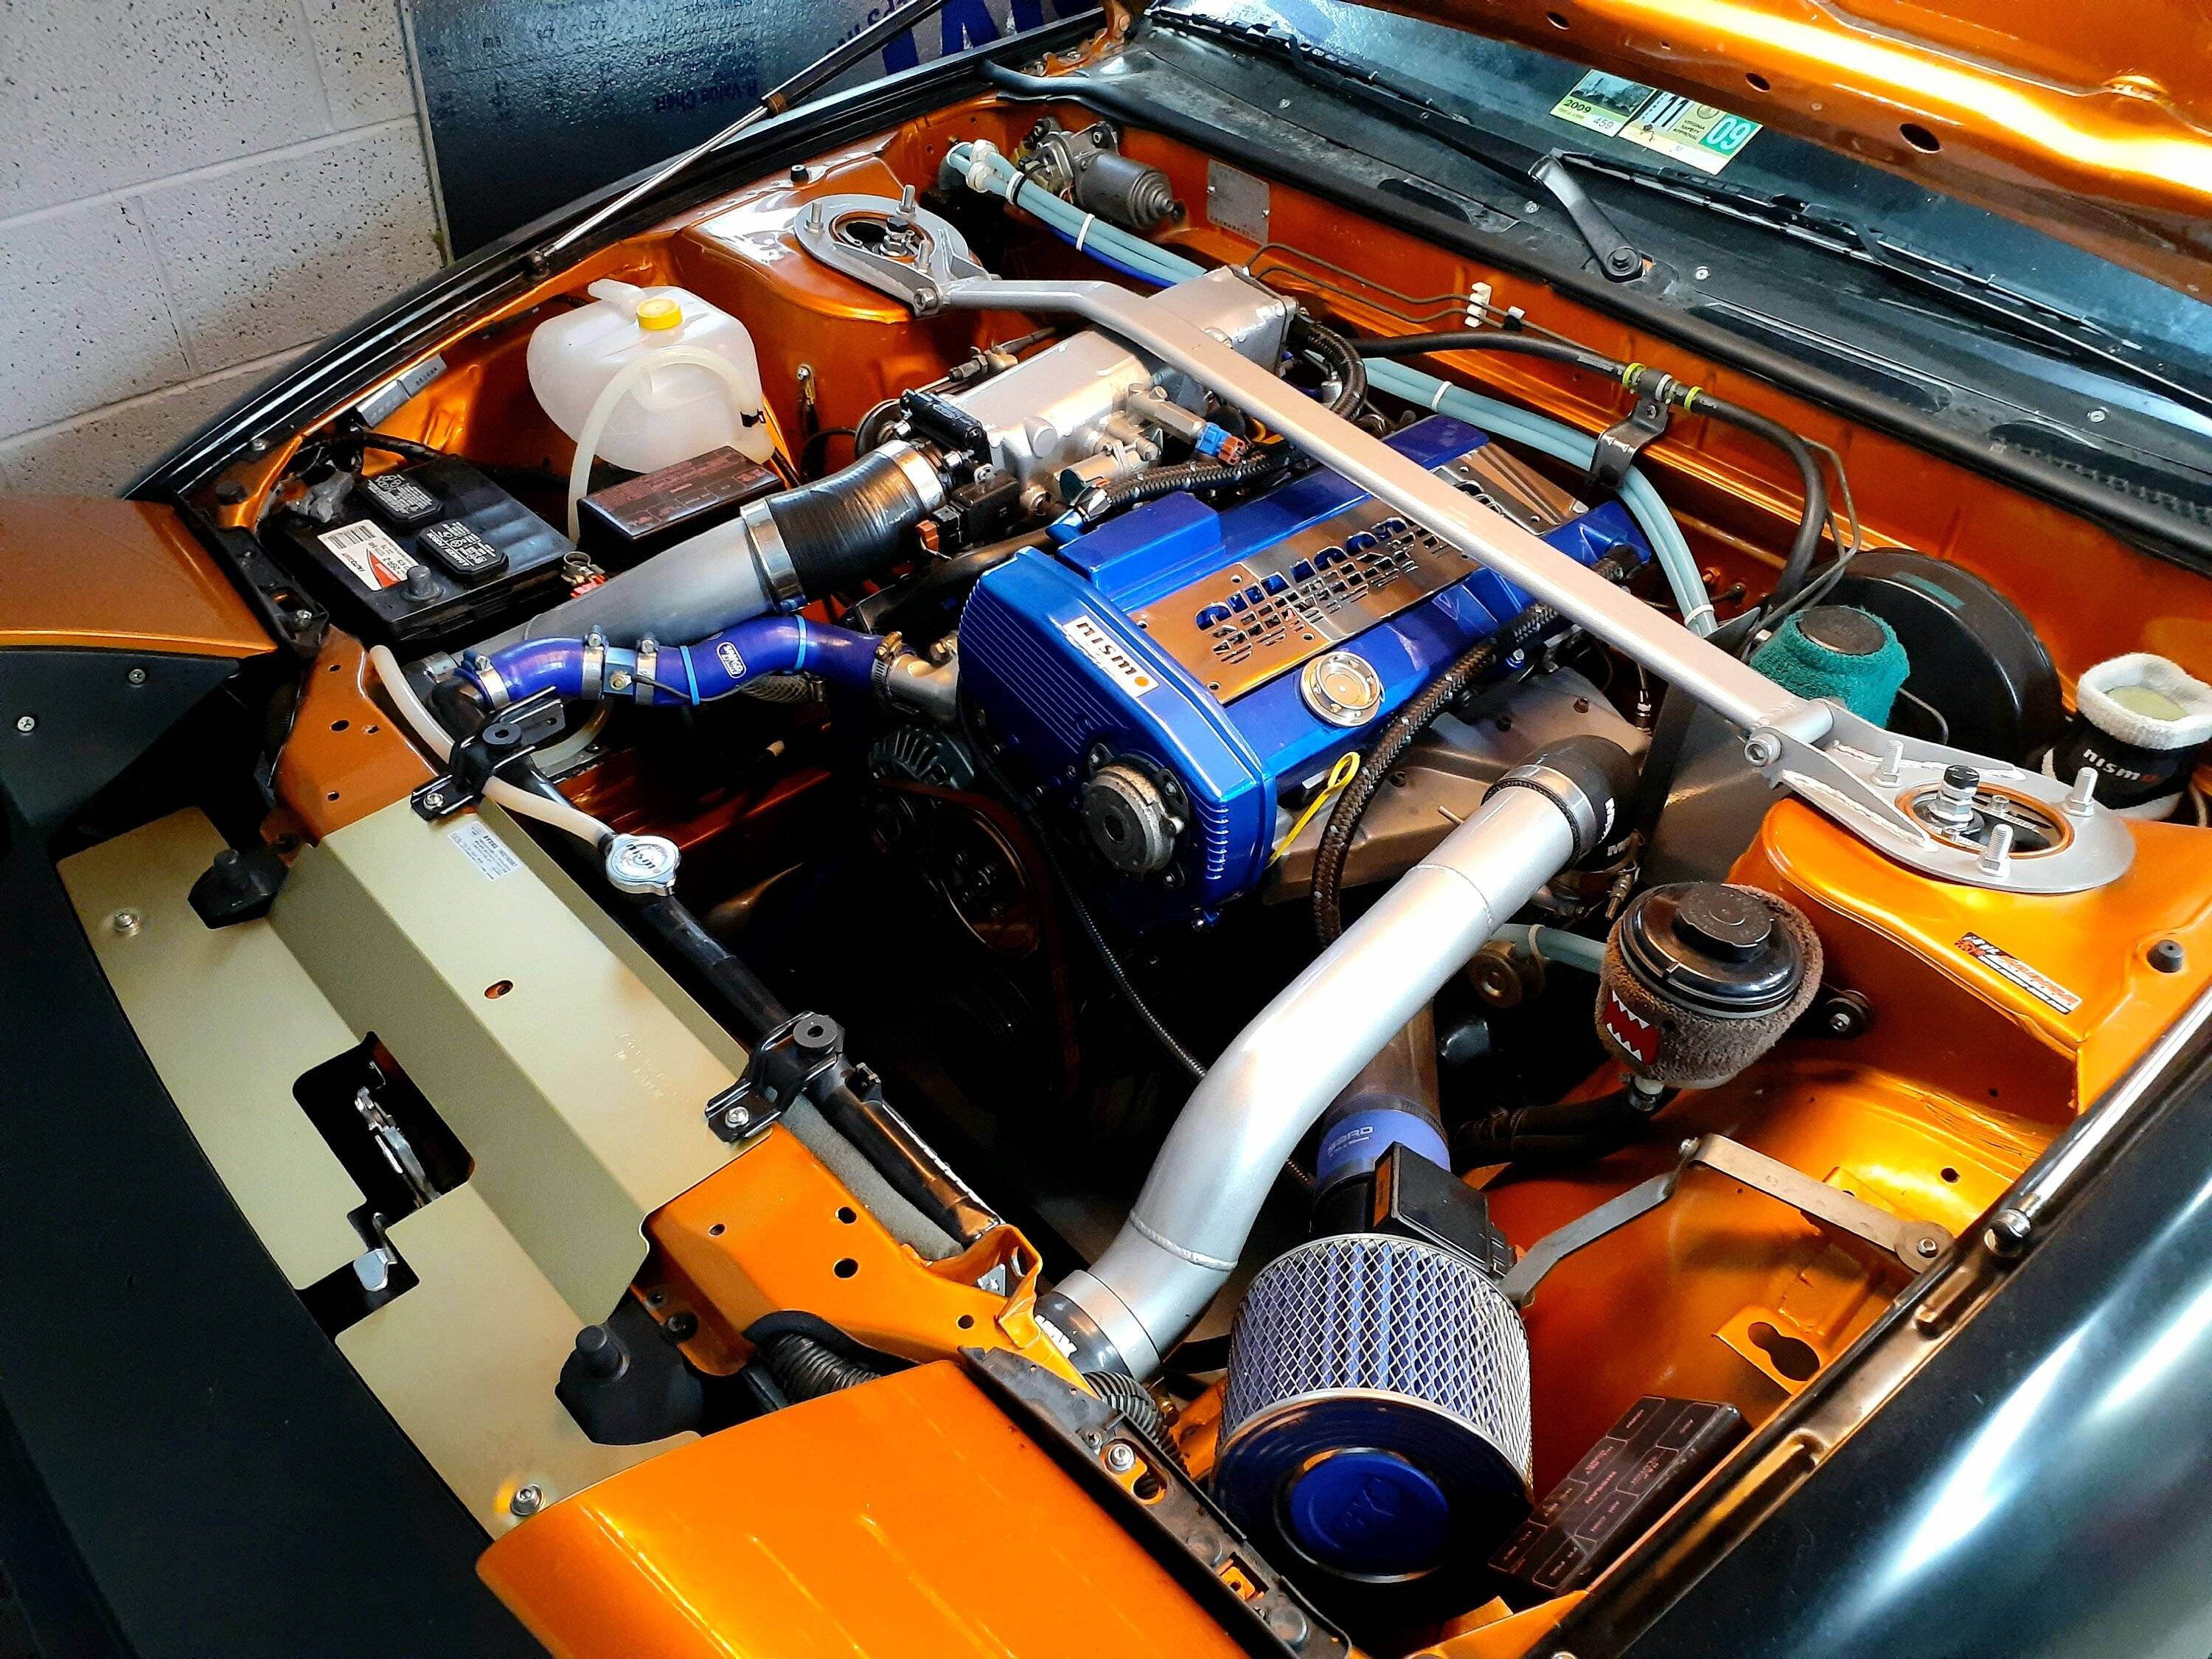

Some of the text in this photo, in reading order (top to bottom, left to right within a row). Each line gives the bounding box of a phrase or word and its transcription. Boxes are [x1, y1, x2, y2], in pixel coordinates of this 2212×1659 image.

[1563, 99, 1592, 114] 2009
[1593, 117, 1615, 130] 459
[1672, 128, 1699, 141] APPROVAL
[1706, 116, 1752, 151] 09
